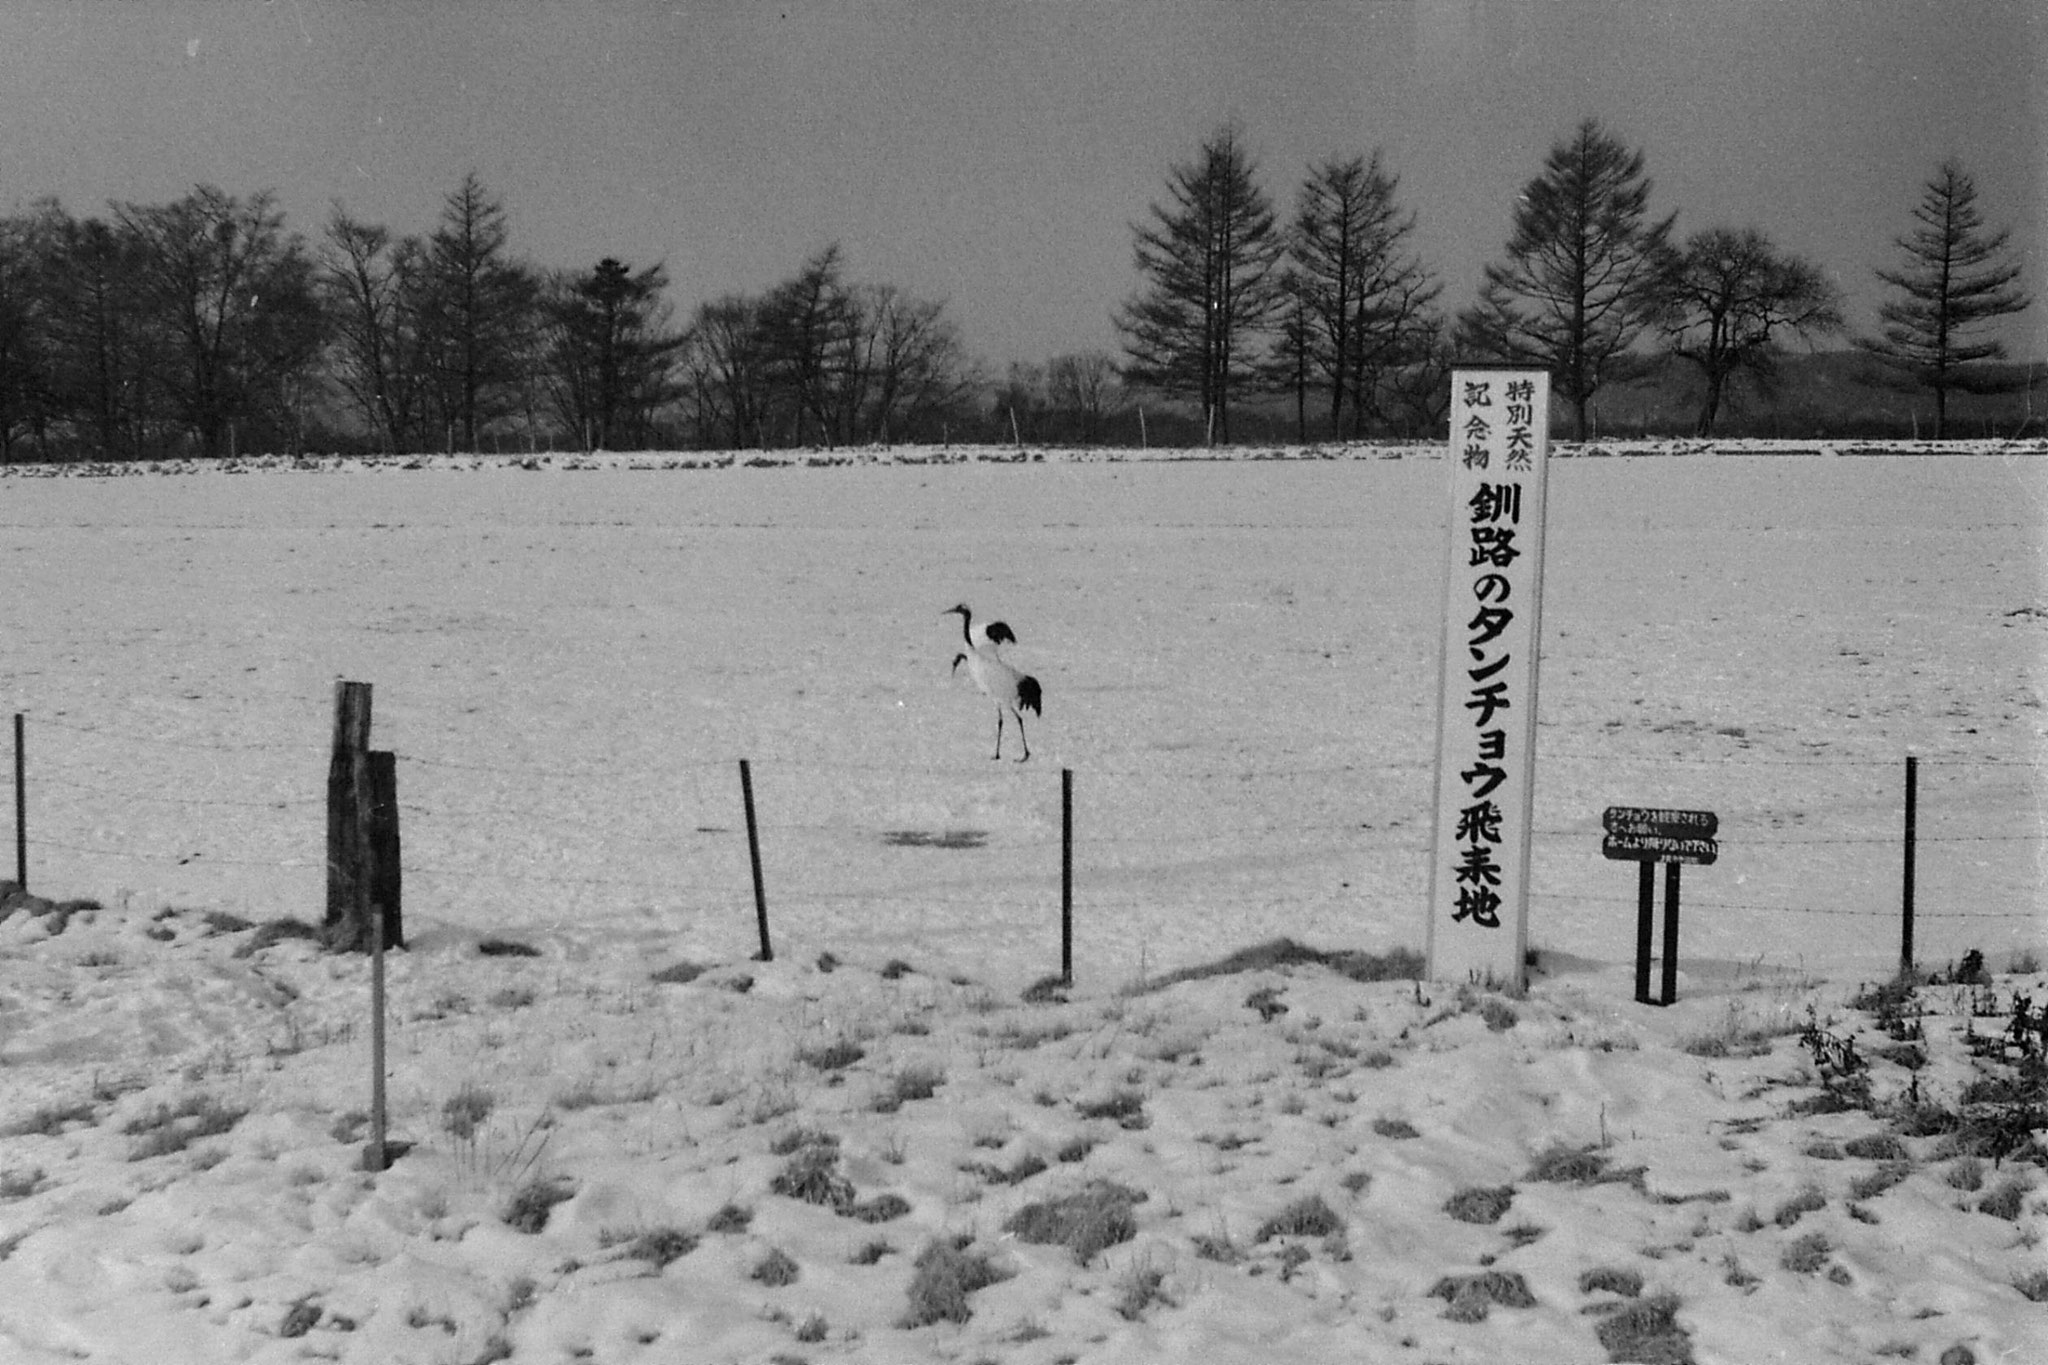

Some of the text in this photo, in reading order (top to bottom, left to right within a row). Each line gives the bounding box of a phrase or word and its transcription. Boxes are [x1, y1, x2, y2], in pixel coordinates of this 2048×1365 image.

[1462, 382, 1492, 470] 記念物
[1505, 379, 1535, 472] 特別天然
[1452, 483, 1522, 928] 釧路のタンチョウ飛来地
